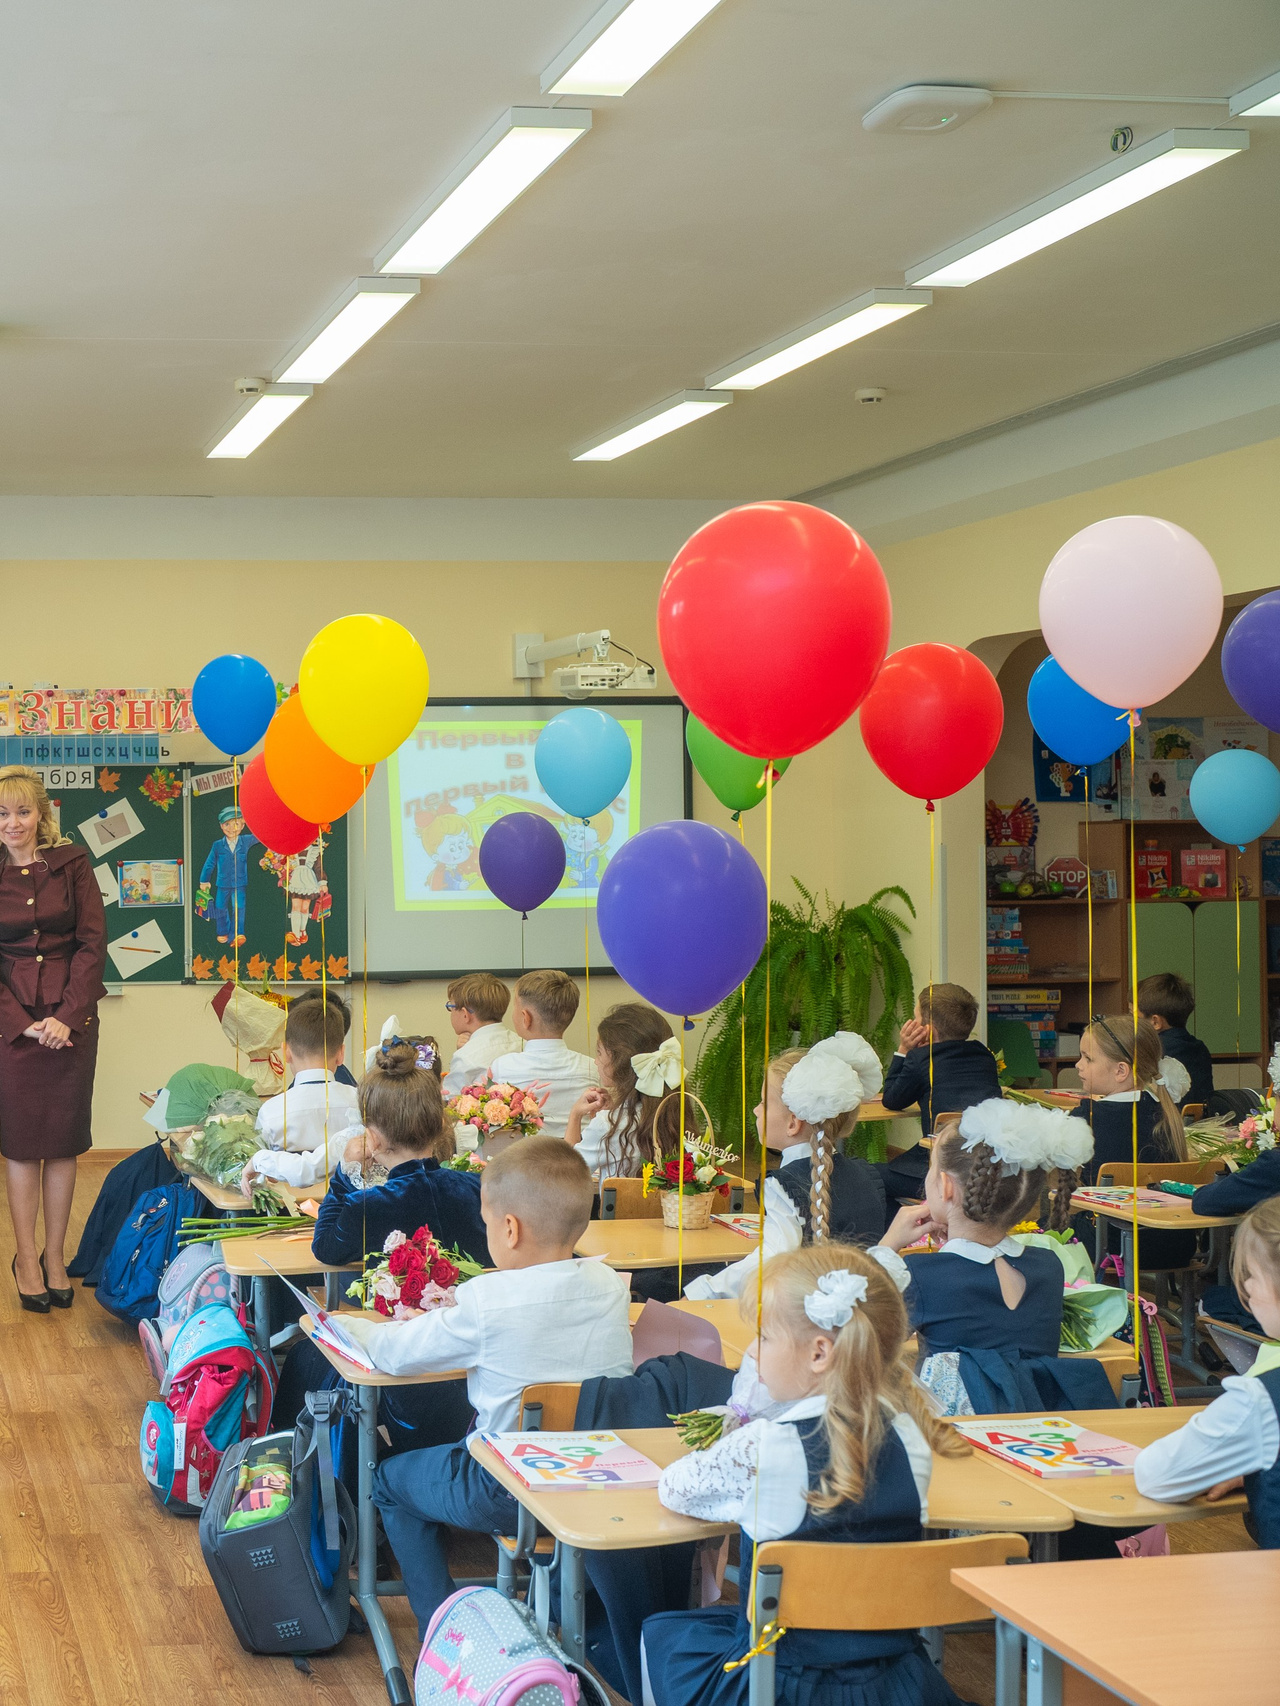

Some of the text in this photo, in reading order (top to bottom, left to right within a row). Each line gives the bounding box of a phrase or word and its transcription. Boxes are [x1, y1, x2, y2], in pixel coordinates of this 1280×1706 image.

[21, 691, 199, 731] Знани
[195, 776, 212, 792] МЫ
[1049, 870, 1087, 883] STOP
